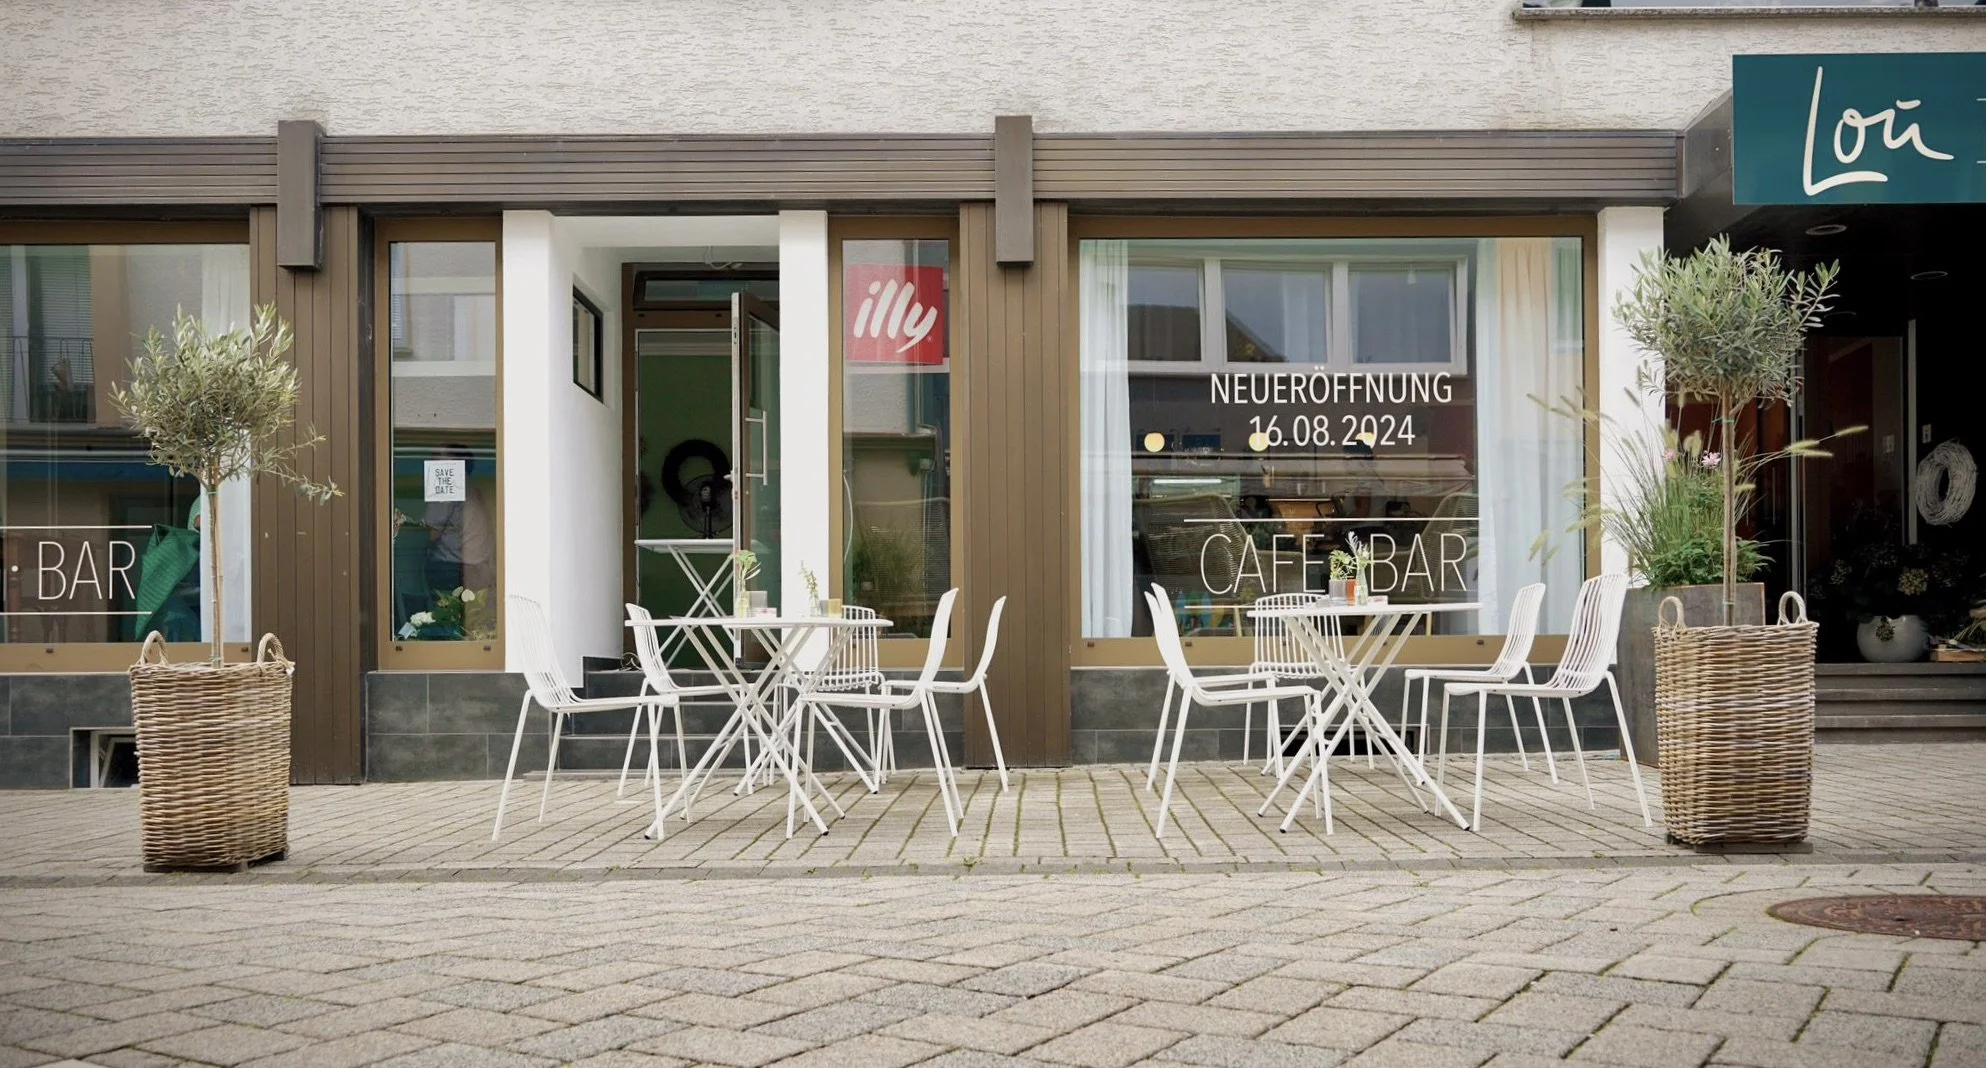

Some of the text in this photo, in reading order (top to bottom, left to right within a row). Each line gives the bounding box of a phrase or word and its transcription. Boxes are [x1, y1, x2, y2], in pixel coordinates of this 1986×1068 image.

[853, 279, 938, 353] illy
[1210, 365, 1453, 404] NEUERÖFFNUNG
[1249, 414, 1416, 448] 16.08.2024
[435, 468, 454, 476] SAVE
[435, 486, 454, 494] DATE
[437, 477, 452, 486] THE
[38, 540, 136, 600] BAR
[1200, 532, 1468, 595] CAFE BAR
